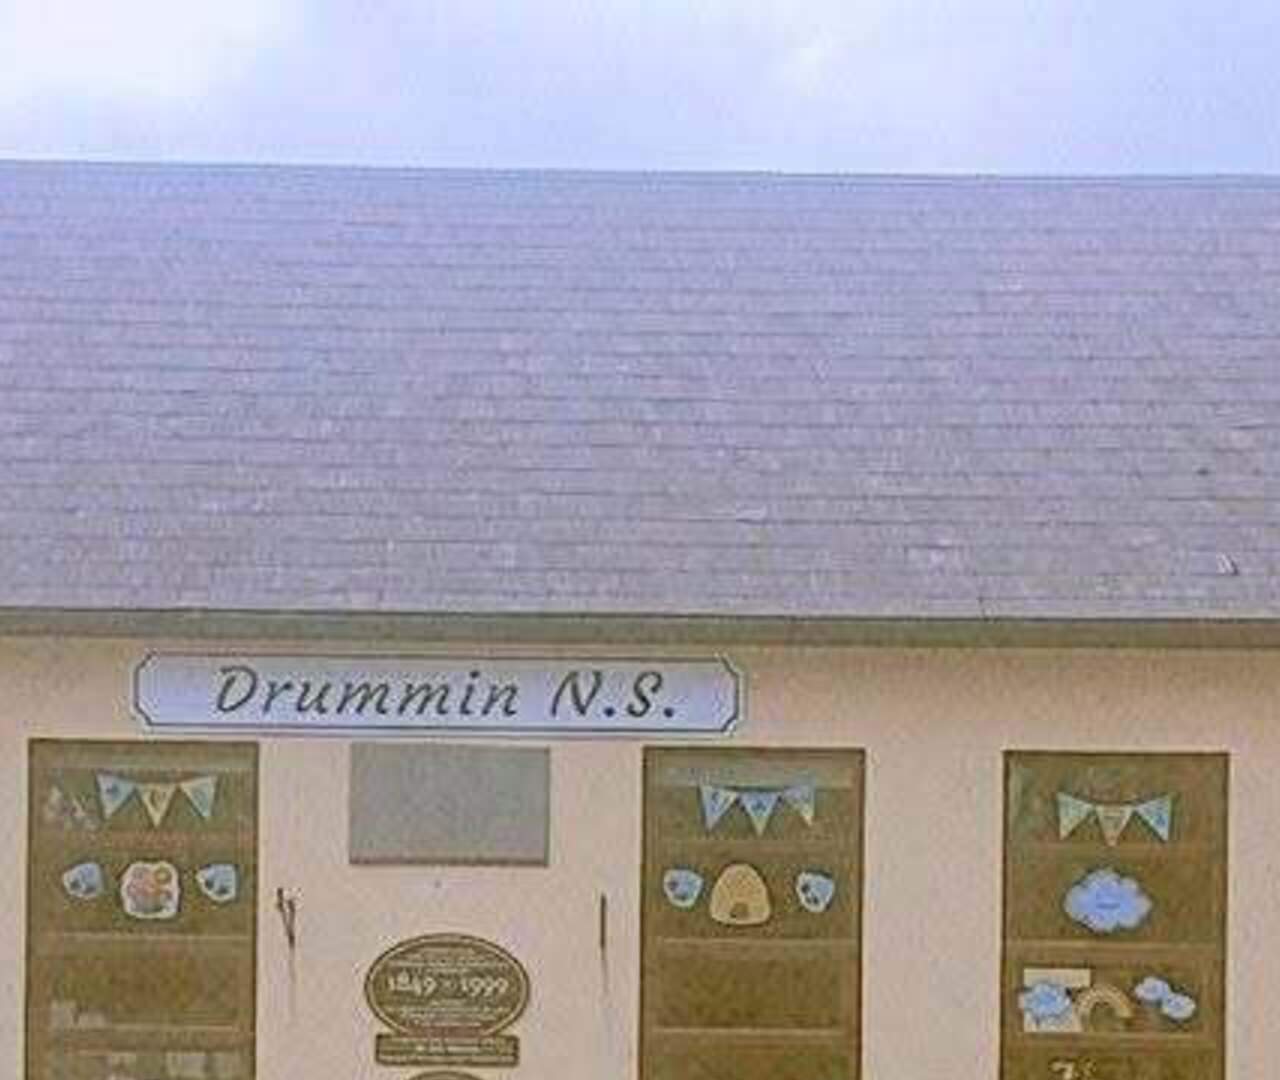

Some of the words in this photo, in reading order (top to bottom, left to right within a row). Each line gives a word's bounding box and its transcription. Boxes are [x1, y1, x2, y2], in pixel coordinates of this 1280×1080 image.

[215, 666, 519, 714] Drummin
[550, 669, 675, 717] N.S.
[459, 976, 509, 997] 1999
